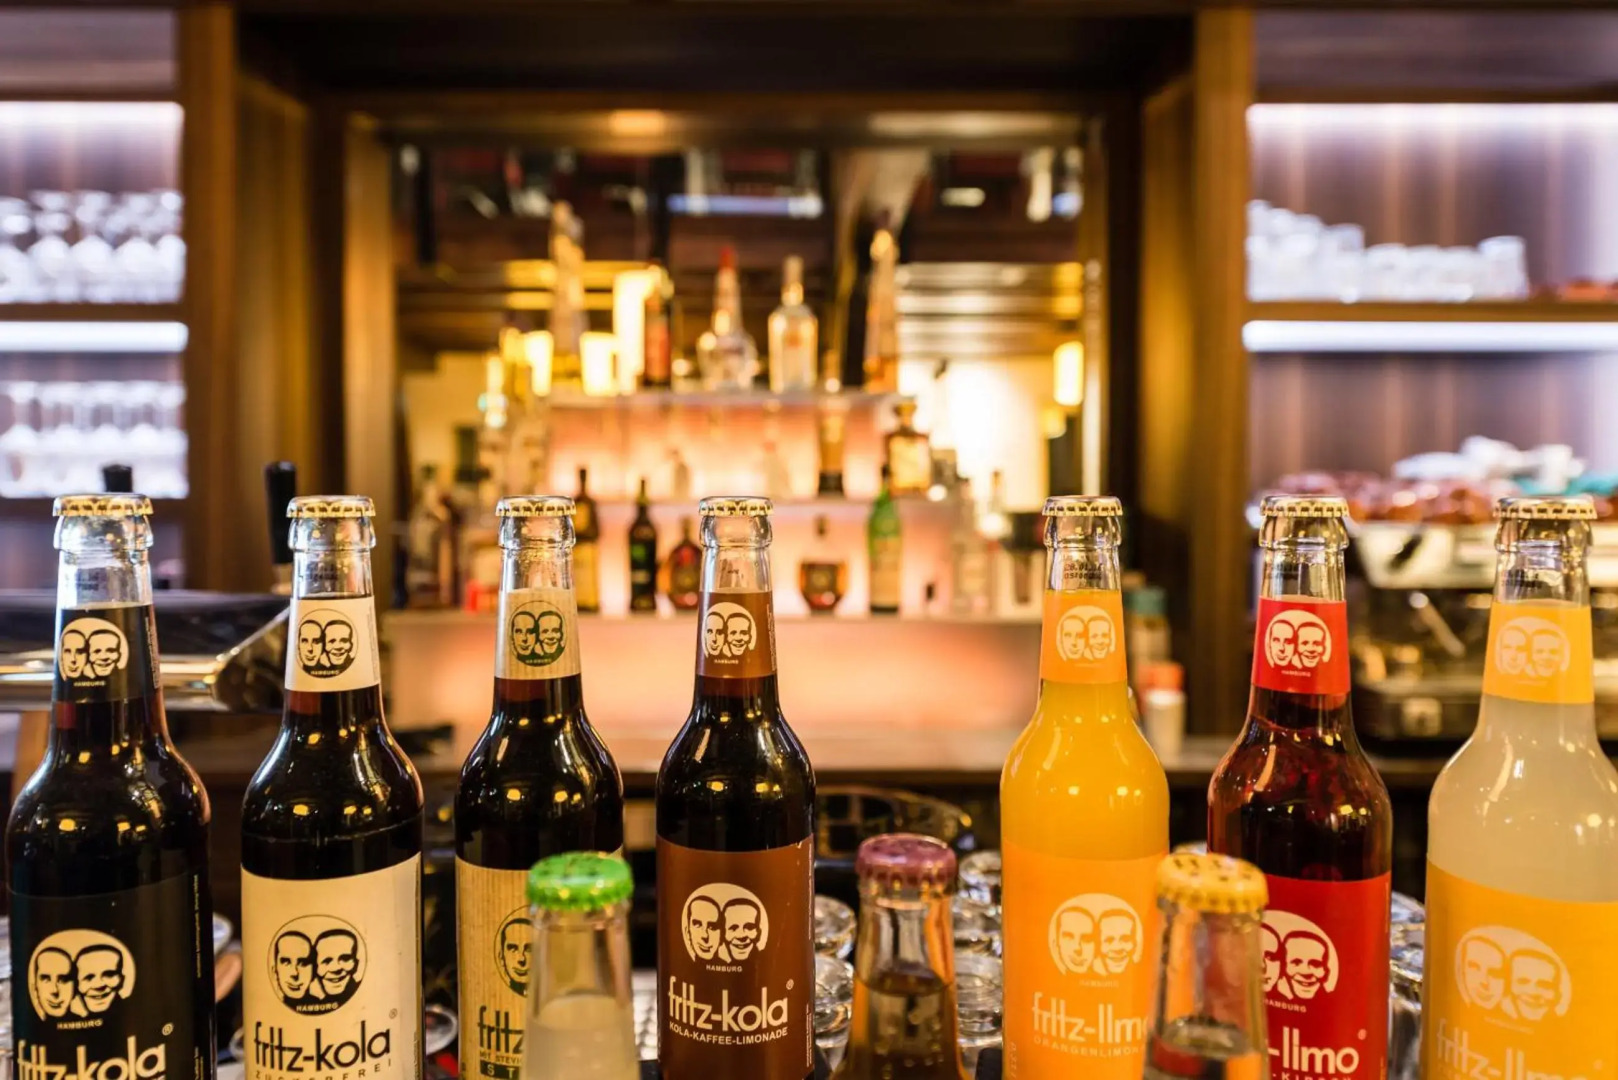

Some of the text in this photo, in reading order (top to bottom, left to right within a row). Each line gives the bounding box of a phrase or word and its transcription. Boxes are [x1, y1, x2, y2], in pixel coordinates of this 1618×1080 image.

[706, 964, 743, 973] HAMBURG
[296, 1001, 339, 1012] HAMBURG
[668, 975, 788, 1032] fritz-kola
[57, 1018, 103, 1030] HAMBURG
[1032, 991, 1148, 1044] fritz-lim
[669, 1020, 788, 1045] KOLA-KAFFEE-LIMONADE
[254, 1020, 391, 1072] fritz-kola
